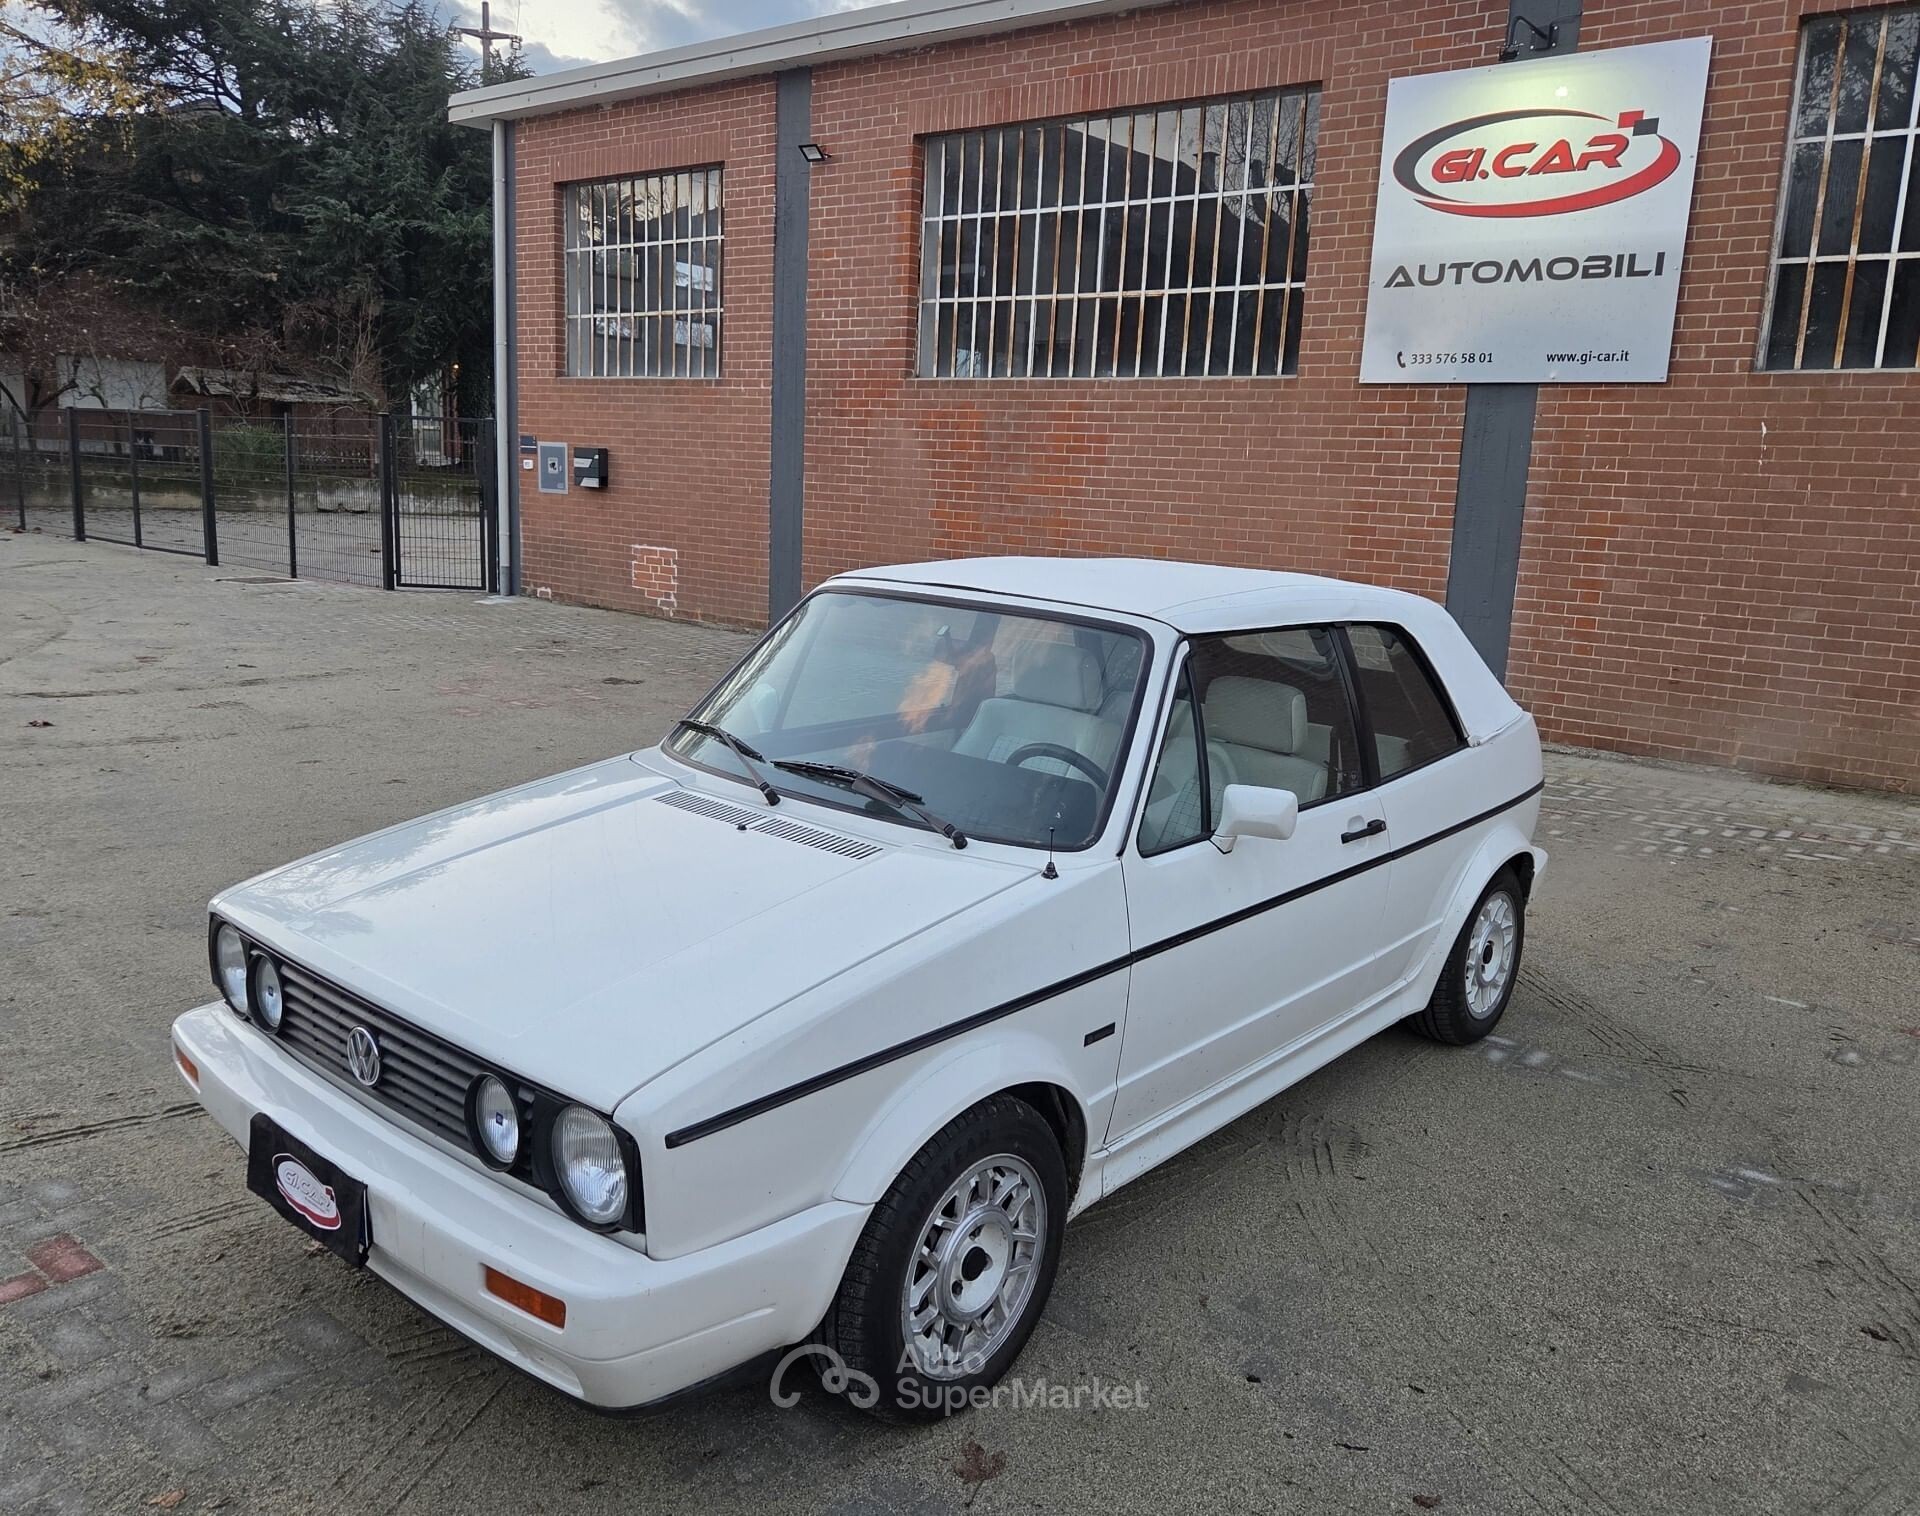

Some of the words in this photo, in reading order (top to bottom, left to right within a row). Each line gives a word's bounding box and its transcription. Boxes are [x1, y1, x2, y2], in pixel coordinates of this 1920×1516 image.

[1431, 133, 1630, 183] GI.CAR
[1383, 252, 1666, 288] AUTOMOBILI
[1410, 353, 1432, 364] 333
[1436, 353, 1457, 364] 576
[1460, 352, 1477, 363] 58
[1479, 352, 1494, 363] 01
[1546, 350, 1630, 365] www.gi-car.it
